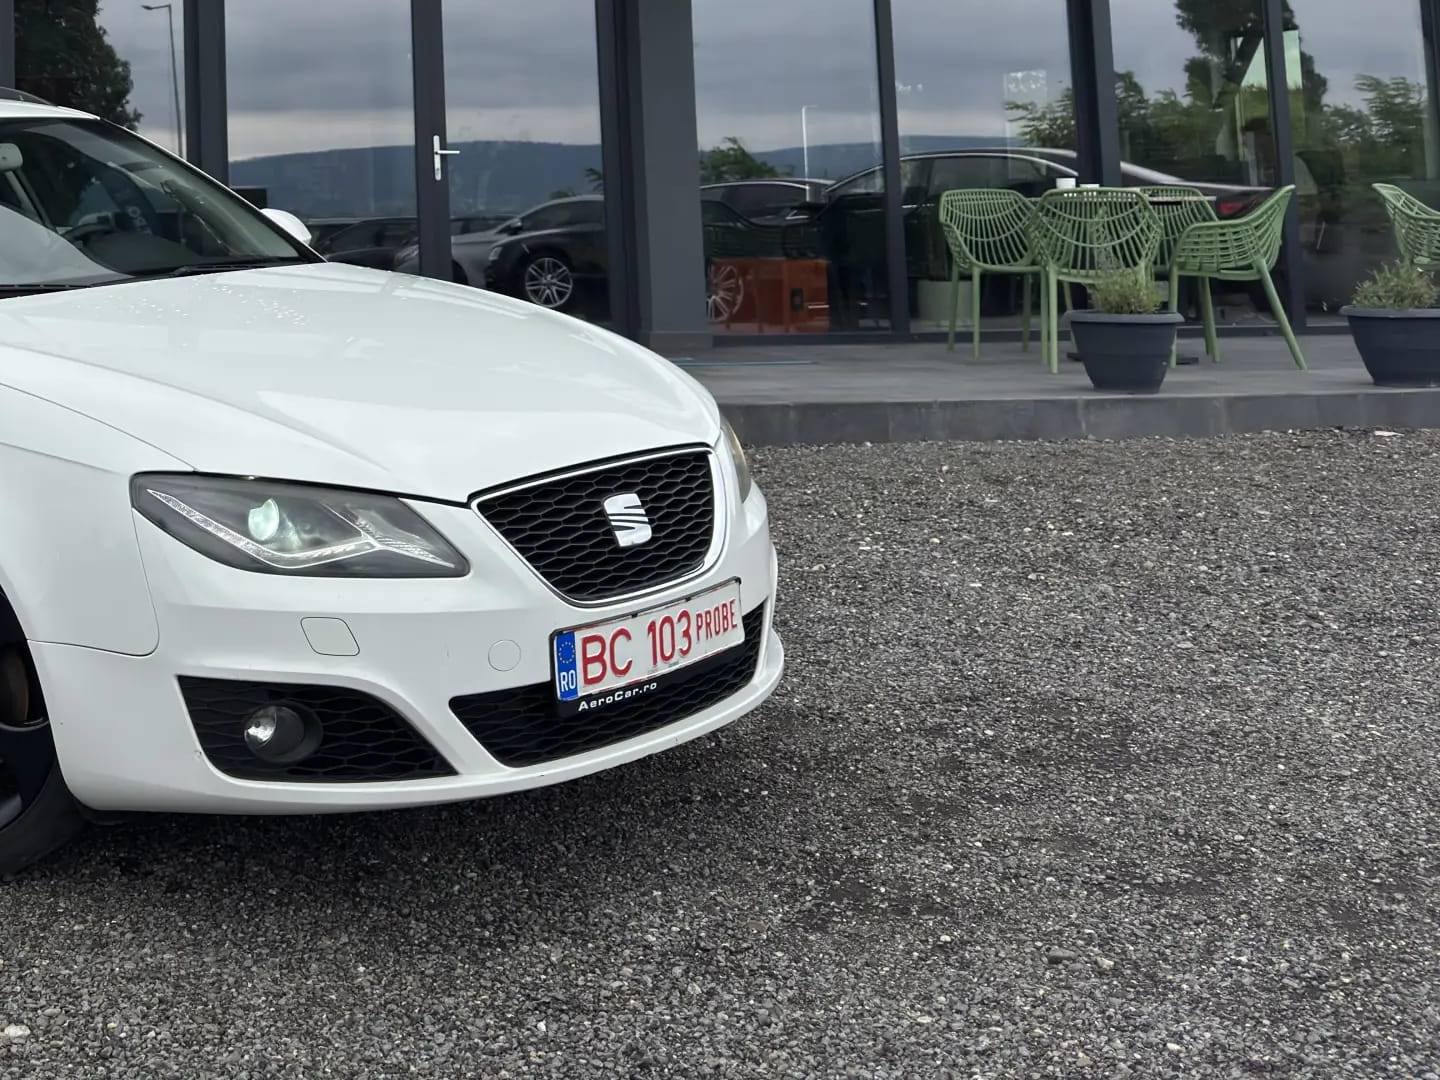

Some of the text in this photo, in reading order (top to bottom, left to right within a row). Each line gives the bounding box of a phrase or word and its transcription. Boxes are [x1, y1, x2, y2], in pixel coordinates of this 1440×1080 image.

[581, 599, 738, 685] BC 103 PROBE
[560, 670, 577, 692] RO
[578, 682, 658, 711] AeroCar.ro
